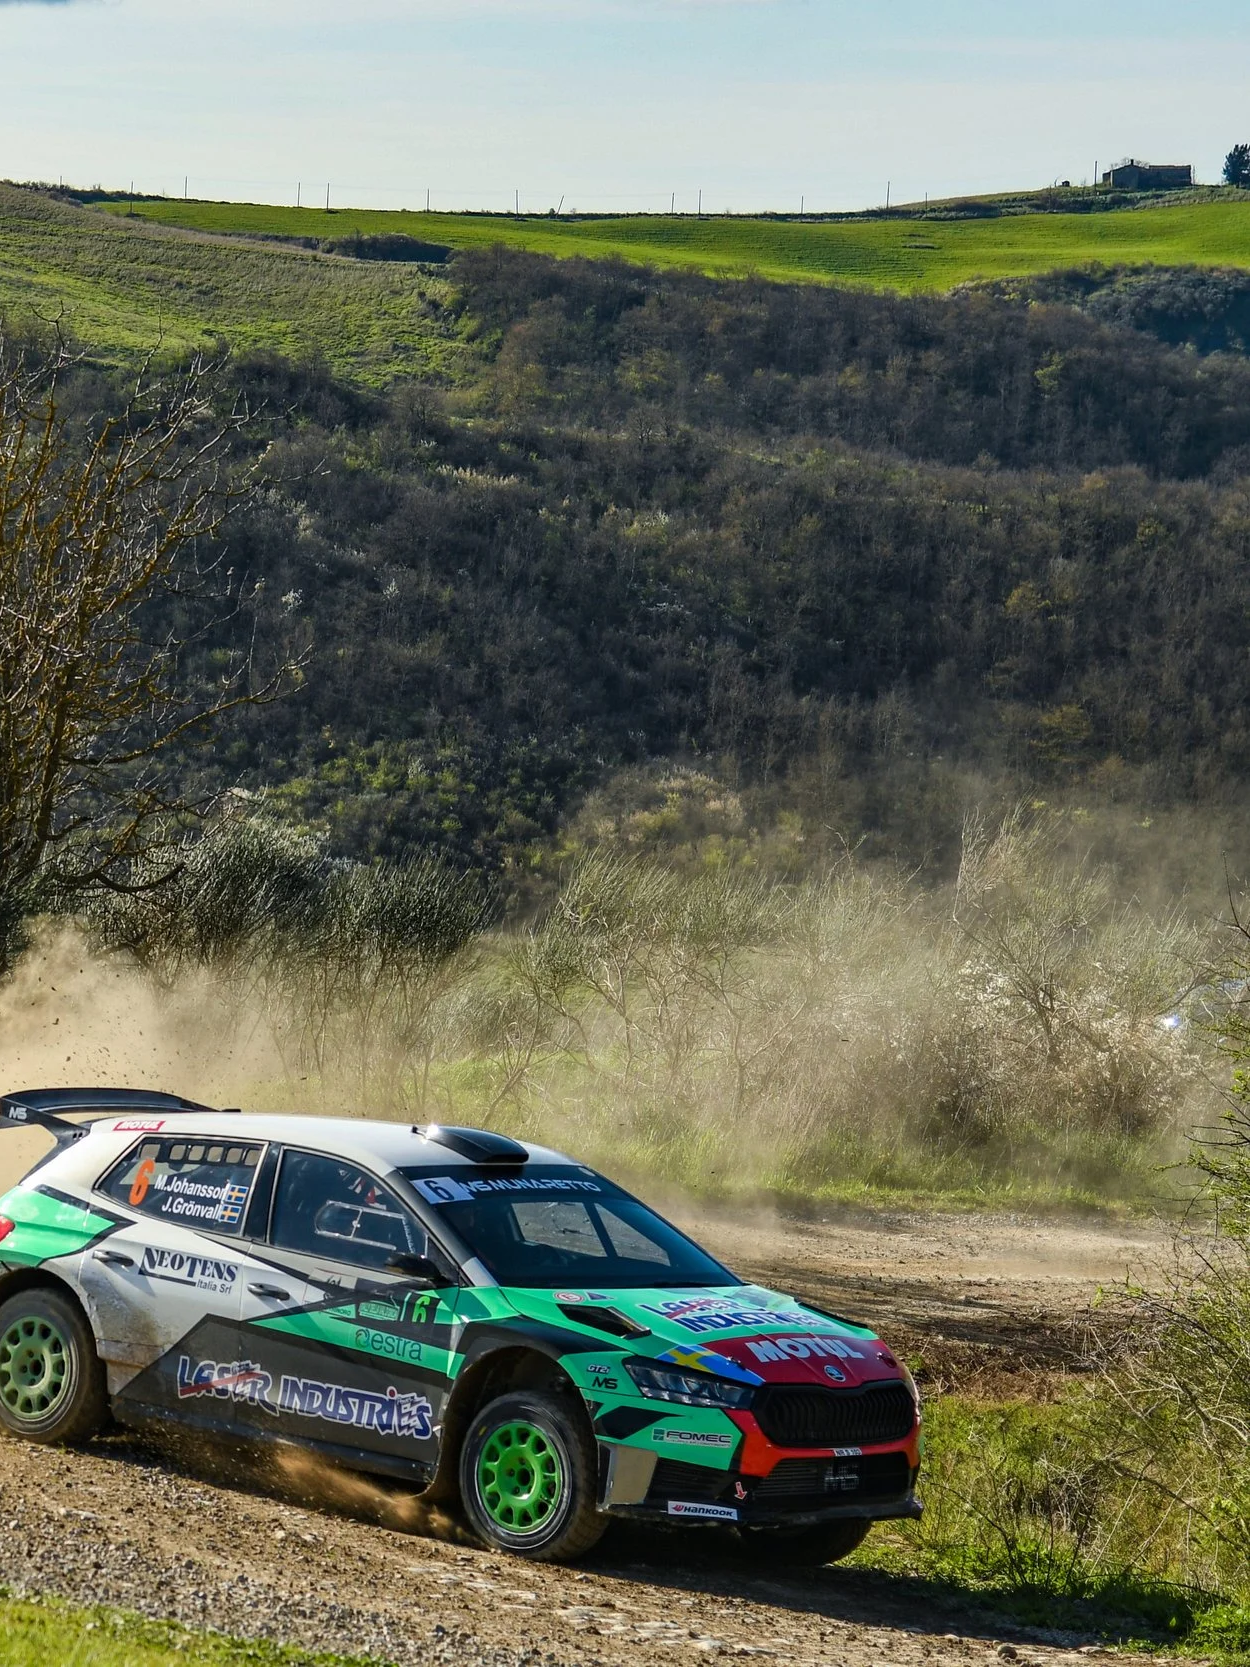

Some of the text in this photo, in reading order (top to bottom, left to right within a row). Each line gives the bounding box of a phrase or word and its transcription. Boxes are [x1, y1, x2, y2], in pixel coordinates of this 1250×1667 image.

[128, 1157, 155, 1206] 6
[154, 1174, 227, 1201] M.Johansson
[423, 1180, 455, 1201] 6
[492, 1178, 602, 1192] MUNARETTO
[161, 1196, 222, 1220] J.Grönvall
[140, 1247, 238, 1282] NEOTENS
[196, 1279, 232, 1294] Italia Srl
[411, 1295, 431, 1323] 6
[371, 1333, 422, 1361] estra
[745, 1336, 865, 1363] MOTUL
[592, 1377, 618, 1390] MS
[278, 1374, 432, 1440] INDUSTRIES
[666, 1430, 731, 1443] FOMEC
